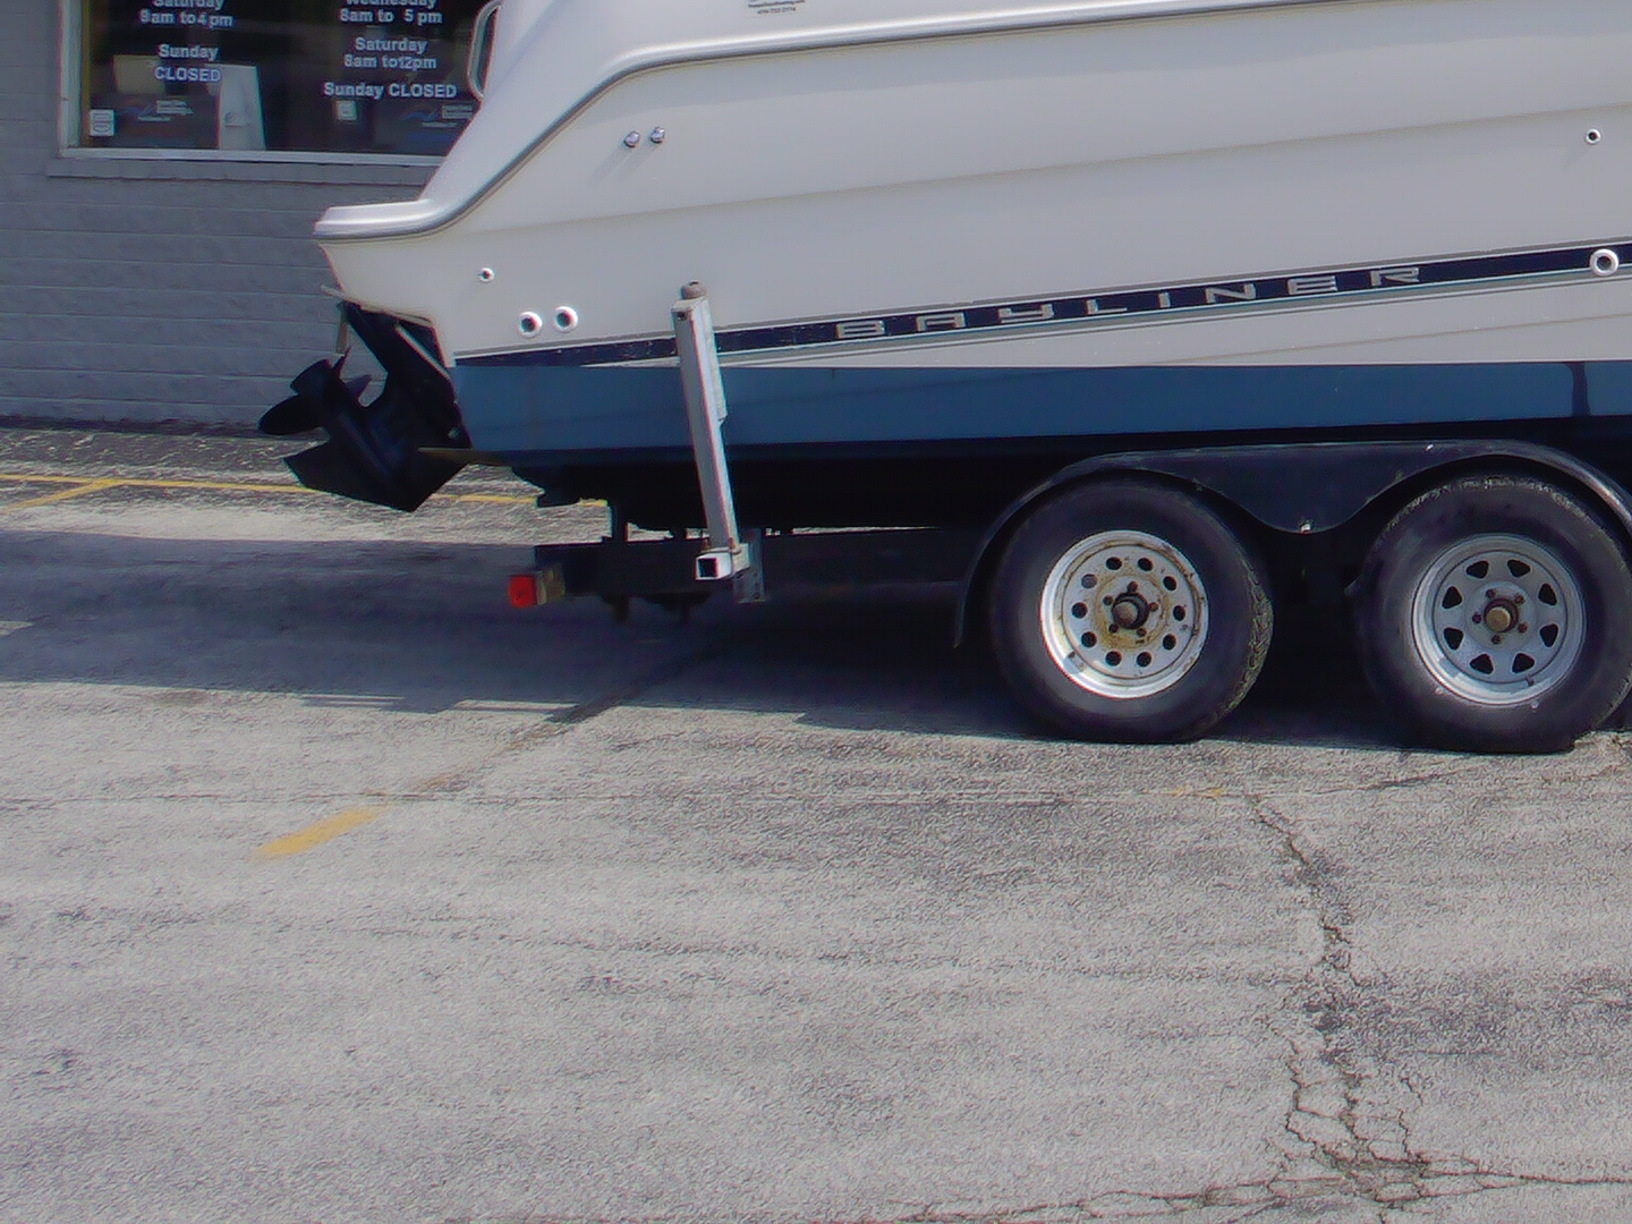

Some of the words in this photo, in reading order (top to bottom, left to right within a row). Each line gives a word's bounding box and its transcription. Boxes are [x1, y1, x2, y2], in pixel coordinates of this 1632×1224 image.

[180, 11, 196, 25] to
[378, 9, 395, 23] to
[158, 44, 219, 62] Sunday
[355, 37, 428, 54] Saturday
[154, 66, 222, 82] CLOSED
[324, 82, 384, 100] Sunday
[388, 83, 457, 98] CLOSED
[835, 265, 1420, 340] BAYLINER
